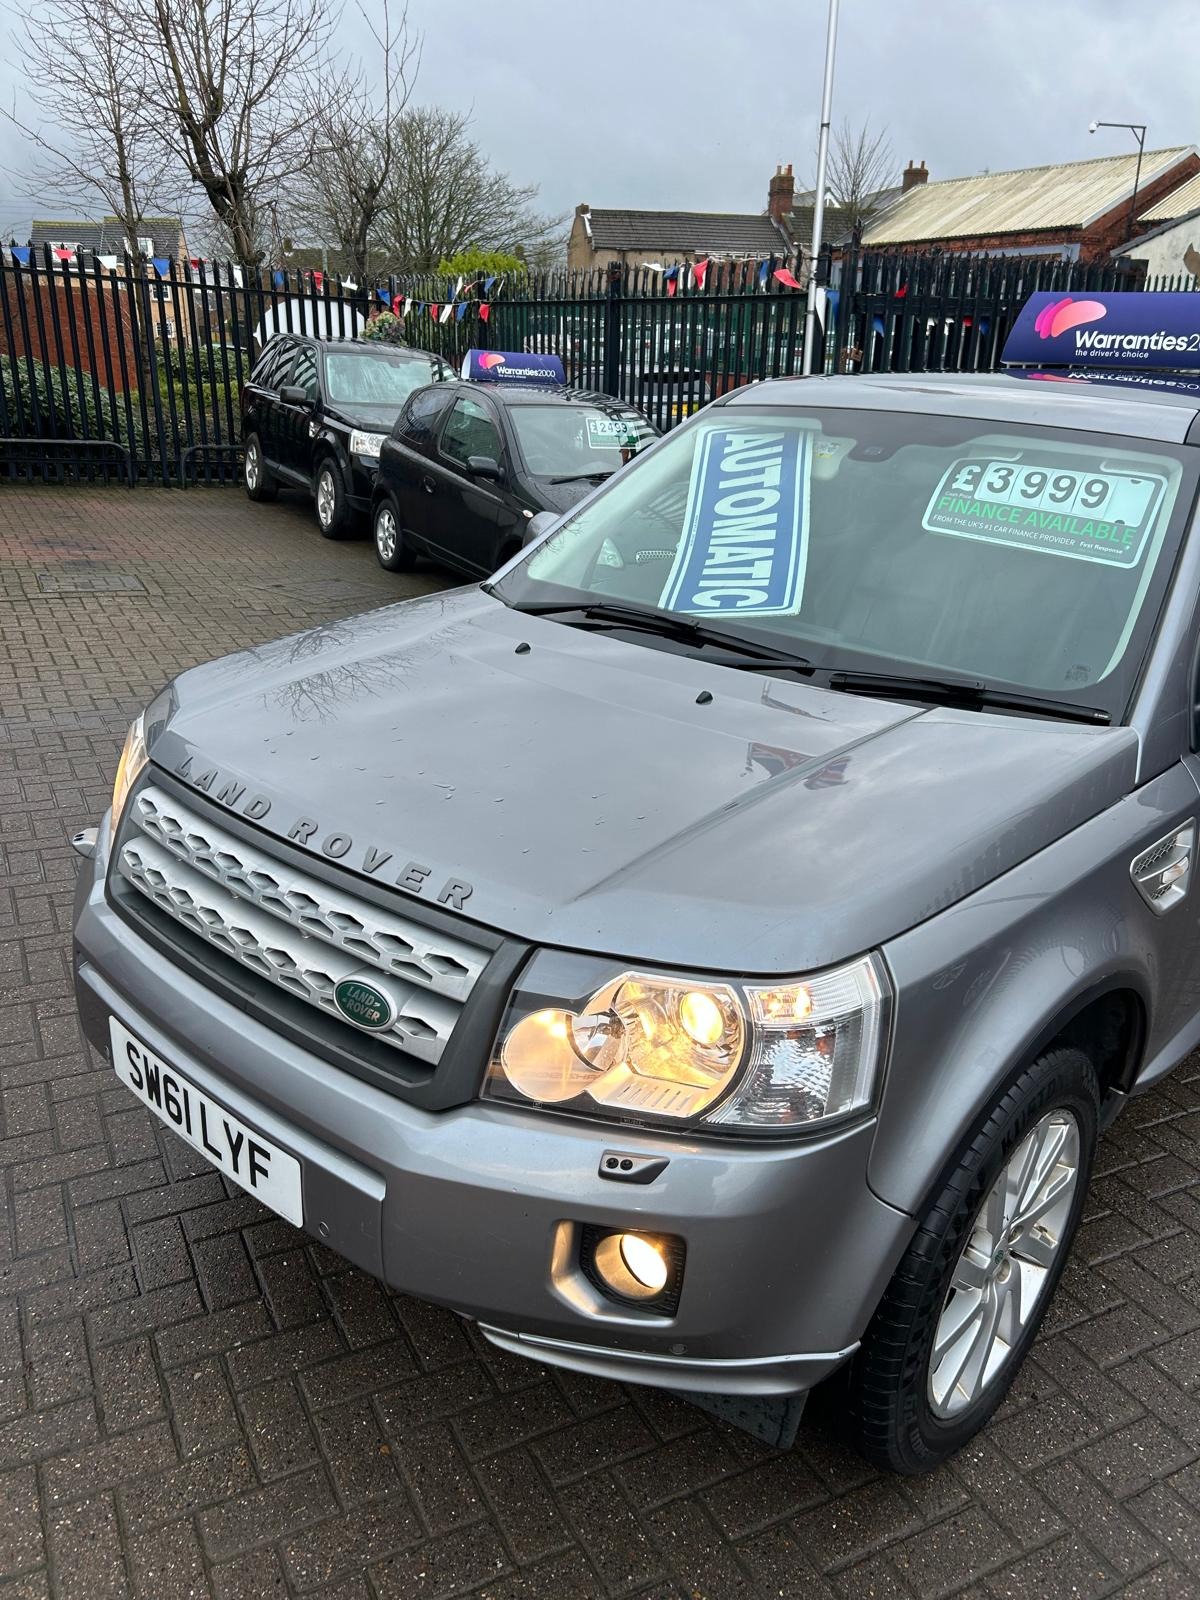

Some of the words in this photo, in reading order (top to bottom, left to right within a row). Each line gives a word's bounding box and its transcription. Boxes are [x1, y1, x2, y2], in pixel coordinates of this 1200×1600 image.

[1075, 330, 1200, 352] Warranties2
[1075, 349, 1088, 357] the
[1089, 350, 1119, 358] driver's
[1121, 350, 1149, 359] choice
[496, 365, 556, 378] Warranties2000
[951, 464, 1110, 509] £3999
[691, 432, 785, 608] AUTOMATIC
[933, 514, 953, 522] FROM
[954, 516, 968, 526] THE
[968, 520, 984, 529] UK'S
[1008, 527, 1039, 539] FINANCE
[1039, 533, 1076, 546] PROVIDER
[936, 496, 1023, 524] FINANCE
[1023, 511, 1137, 546] AVAILABLE
[1079, 541, 1093, 549] First
[1094, 543, 1123, 554] Response
[174, 755, 272, 820] LAND
[287, 815, 474, 910] ROVER
[346, 986, 375, 1007] LAND
[346, 1000, 381, 1022] ROVER
[126, 1041, 192, 1136] SW61
[200, 1100, 271, 1188] LYF
